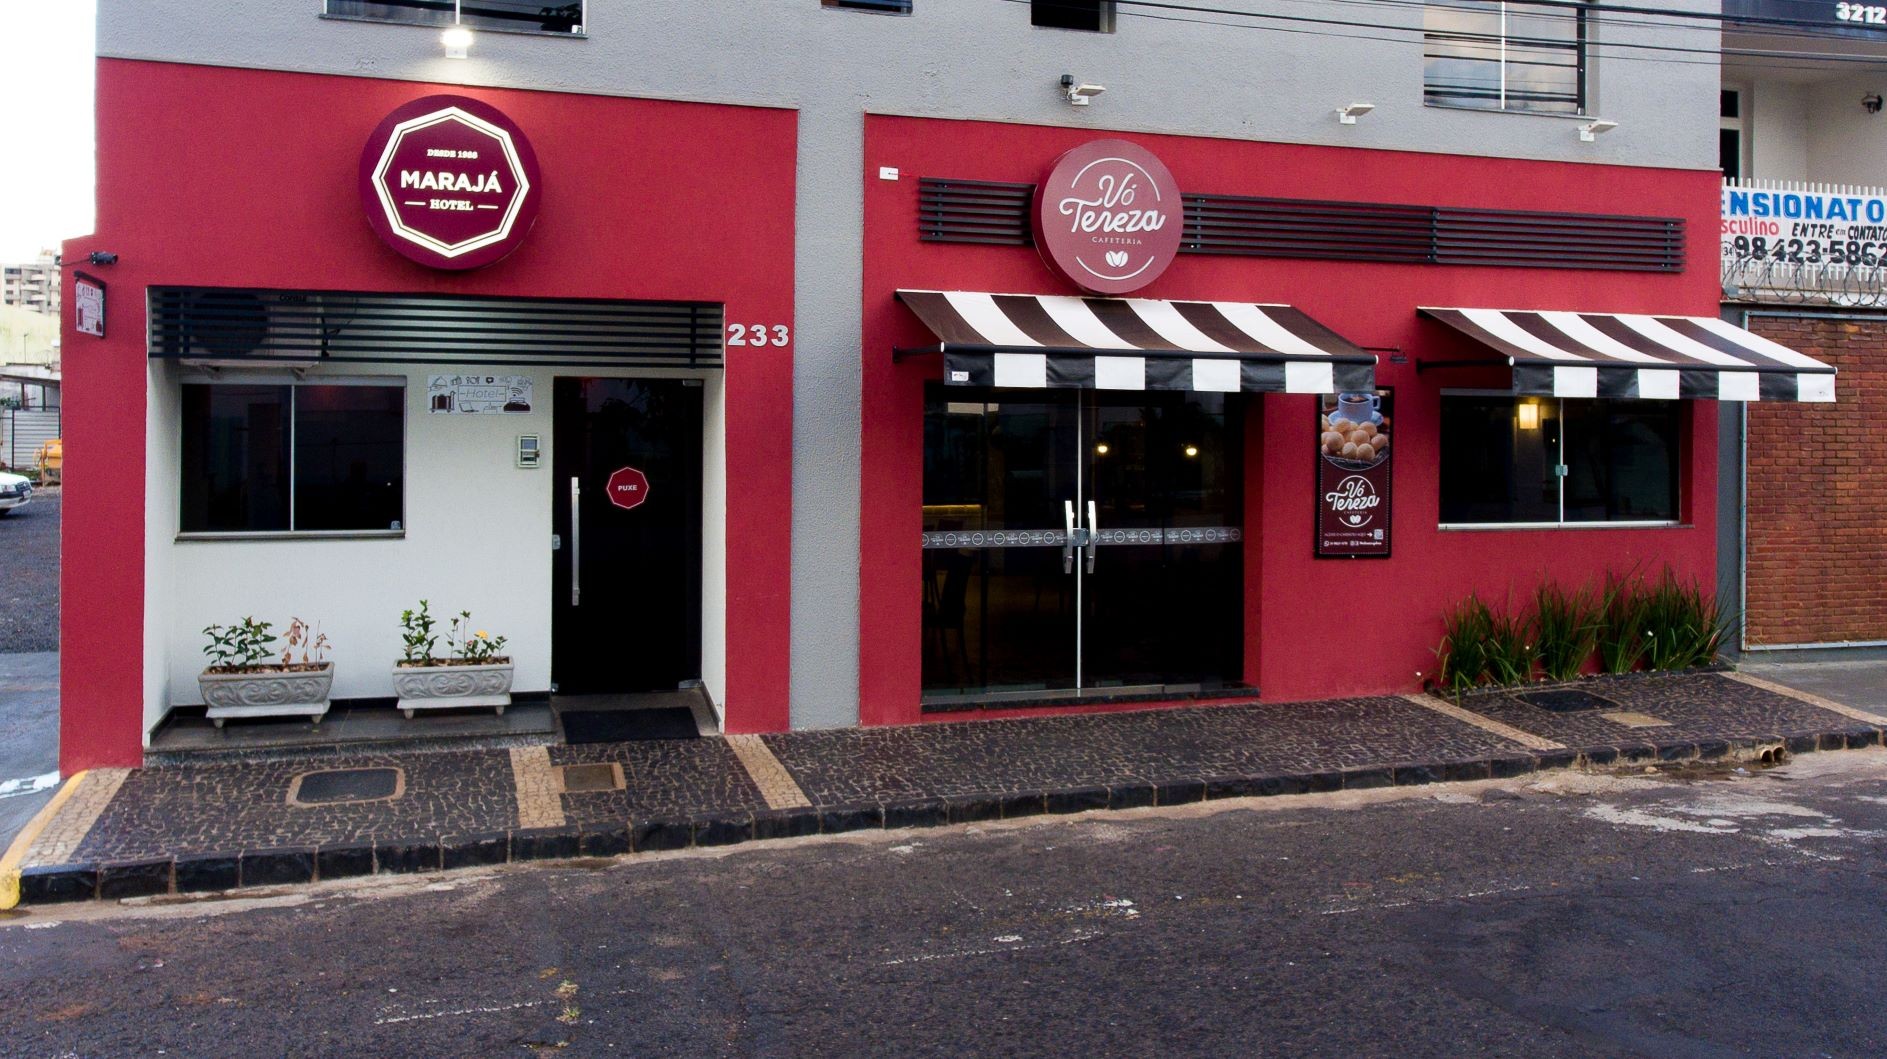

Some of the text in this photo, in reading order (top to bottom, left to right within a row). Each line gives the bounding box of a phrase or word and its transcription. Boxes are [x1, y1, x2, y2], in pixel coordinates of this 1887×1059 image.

[1835, 1, 1887, 24] 3212
[427, 148, 456, 158] DESDE
[401, 170, 502, 193] MARAJÁ
[1098, 173, 1138, 208] Vó
[430, 199, 474, 210] HOTEL
[1721, 190, 1885, 223] NSIONATO
[1059, 197, 1166, 233] Tereza
[1091, 236, 1142, 245] CAFETERIA
[1791, 222, 1834, 239] ENTRE
[727, 323, 789, 347] 233
[465, 388, 499, 399] Hotel
[1346, 480, 1365, 498] Vó
[1326, 491, 1380, 511] Tereza
